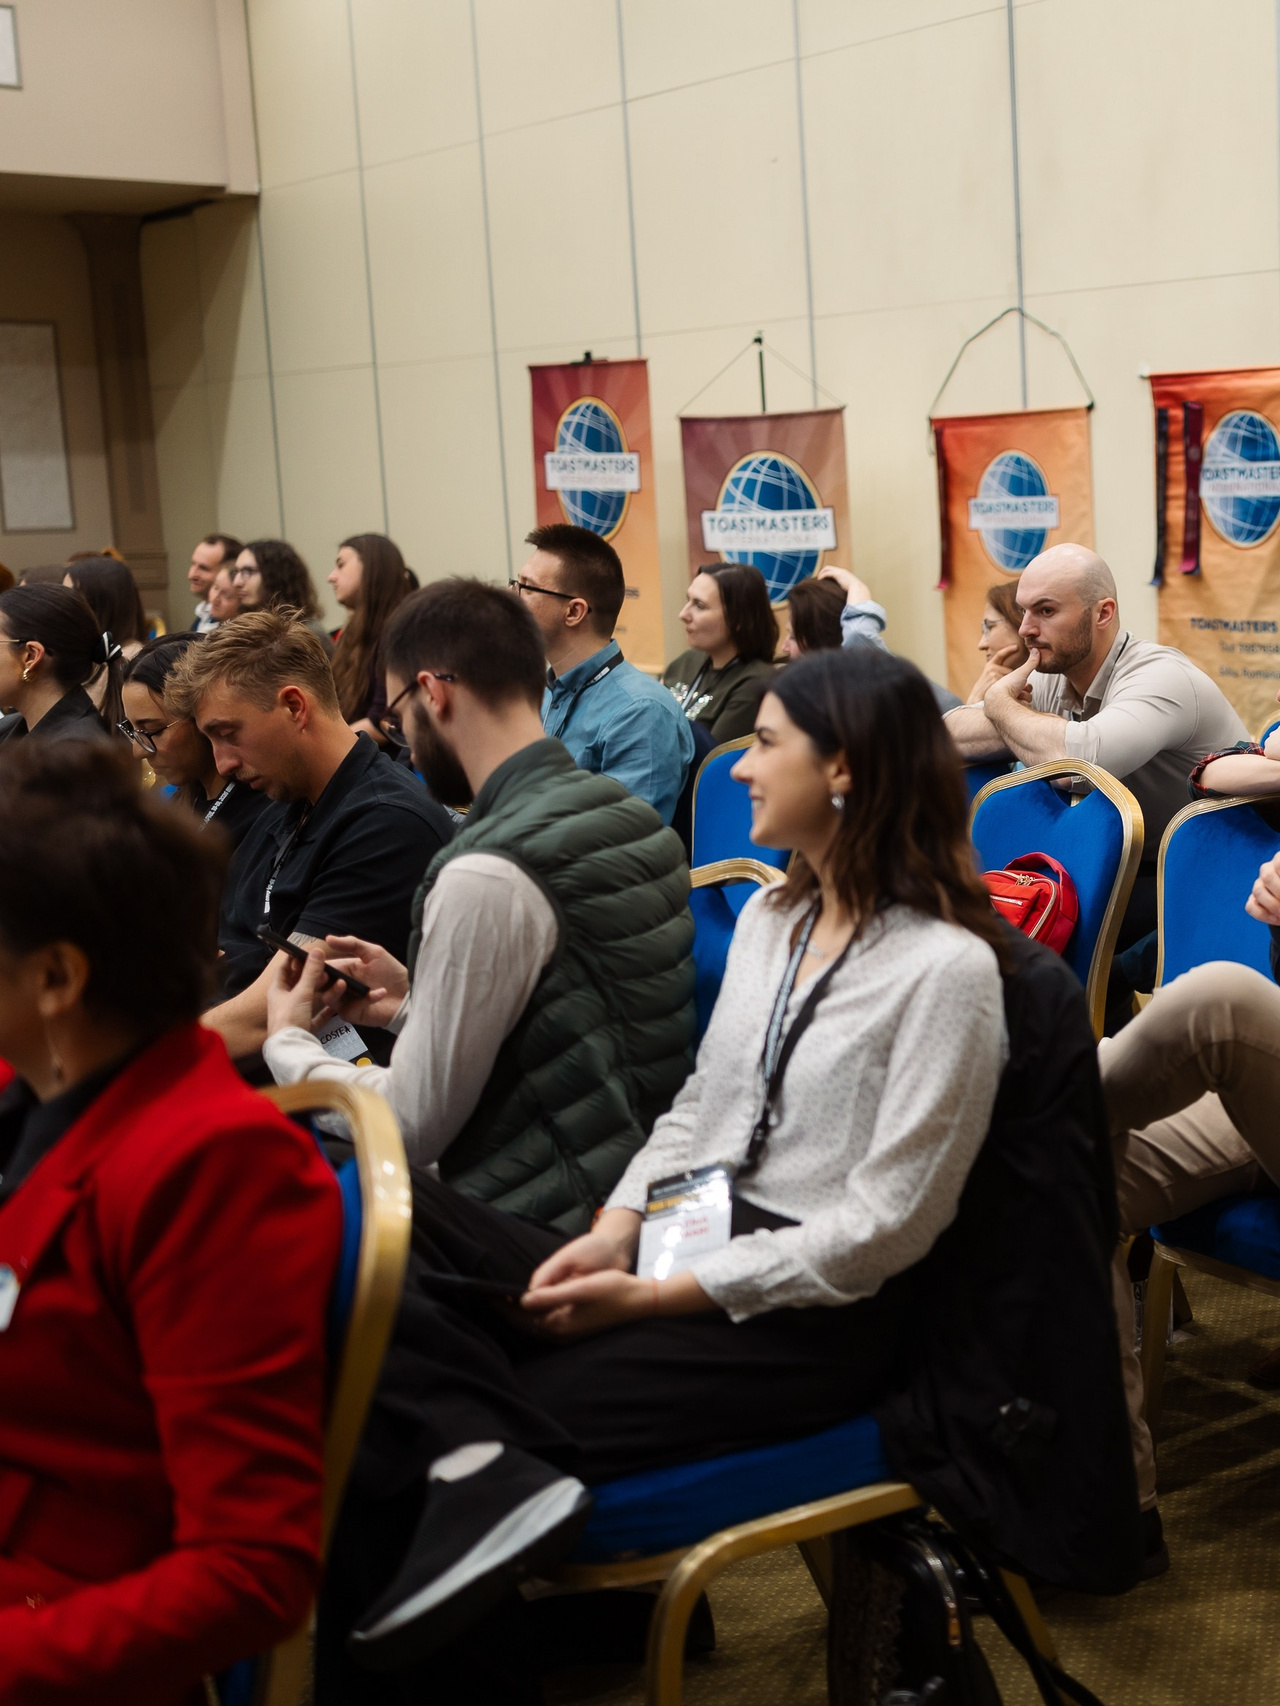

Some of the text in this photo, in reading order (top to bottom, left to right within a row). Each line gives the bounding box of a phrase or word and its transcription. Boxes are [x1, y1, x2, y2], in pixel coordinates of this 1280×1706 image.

[549, 457, 636, 474] TOASTMASTERS
[973, 500, 1055, 515] TOASTMASTERS
[708, 514, 829, 532] TOASTMASTERS
[1191, 618, 1278, 634] TOASTMASTERS
[320, 1025, 351, 1045] COSTEA
